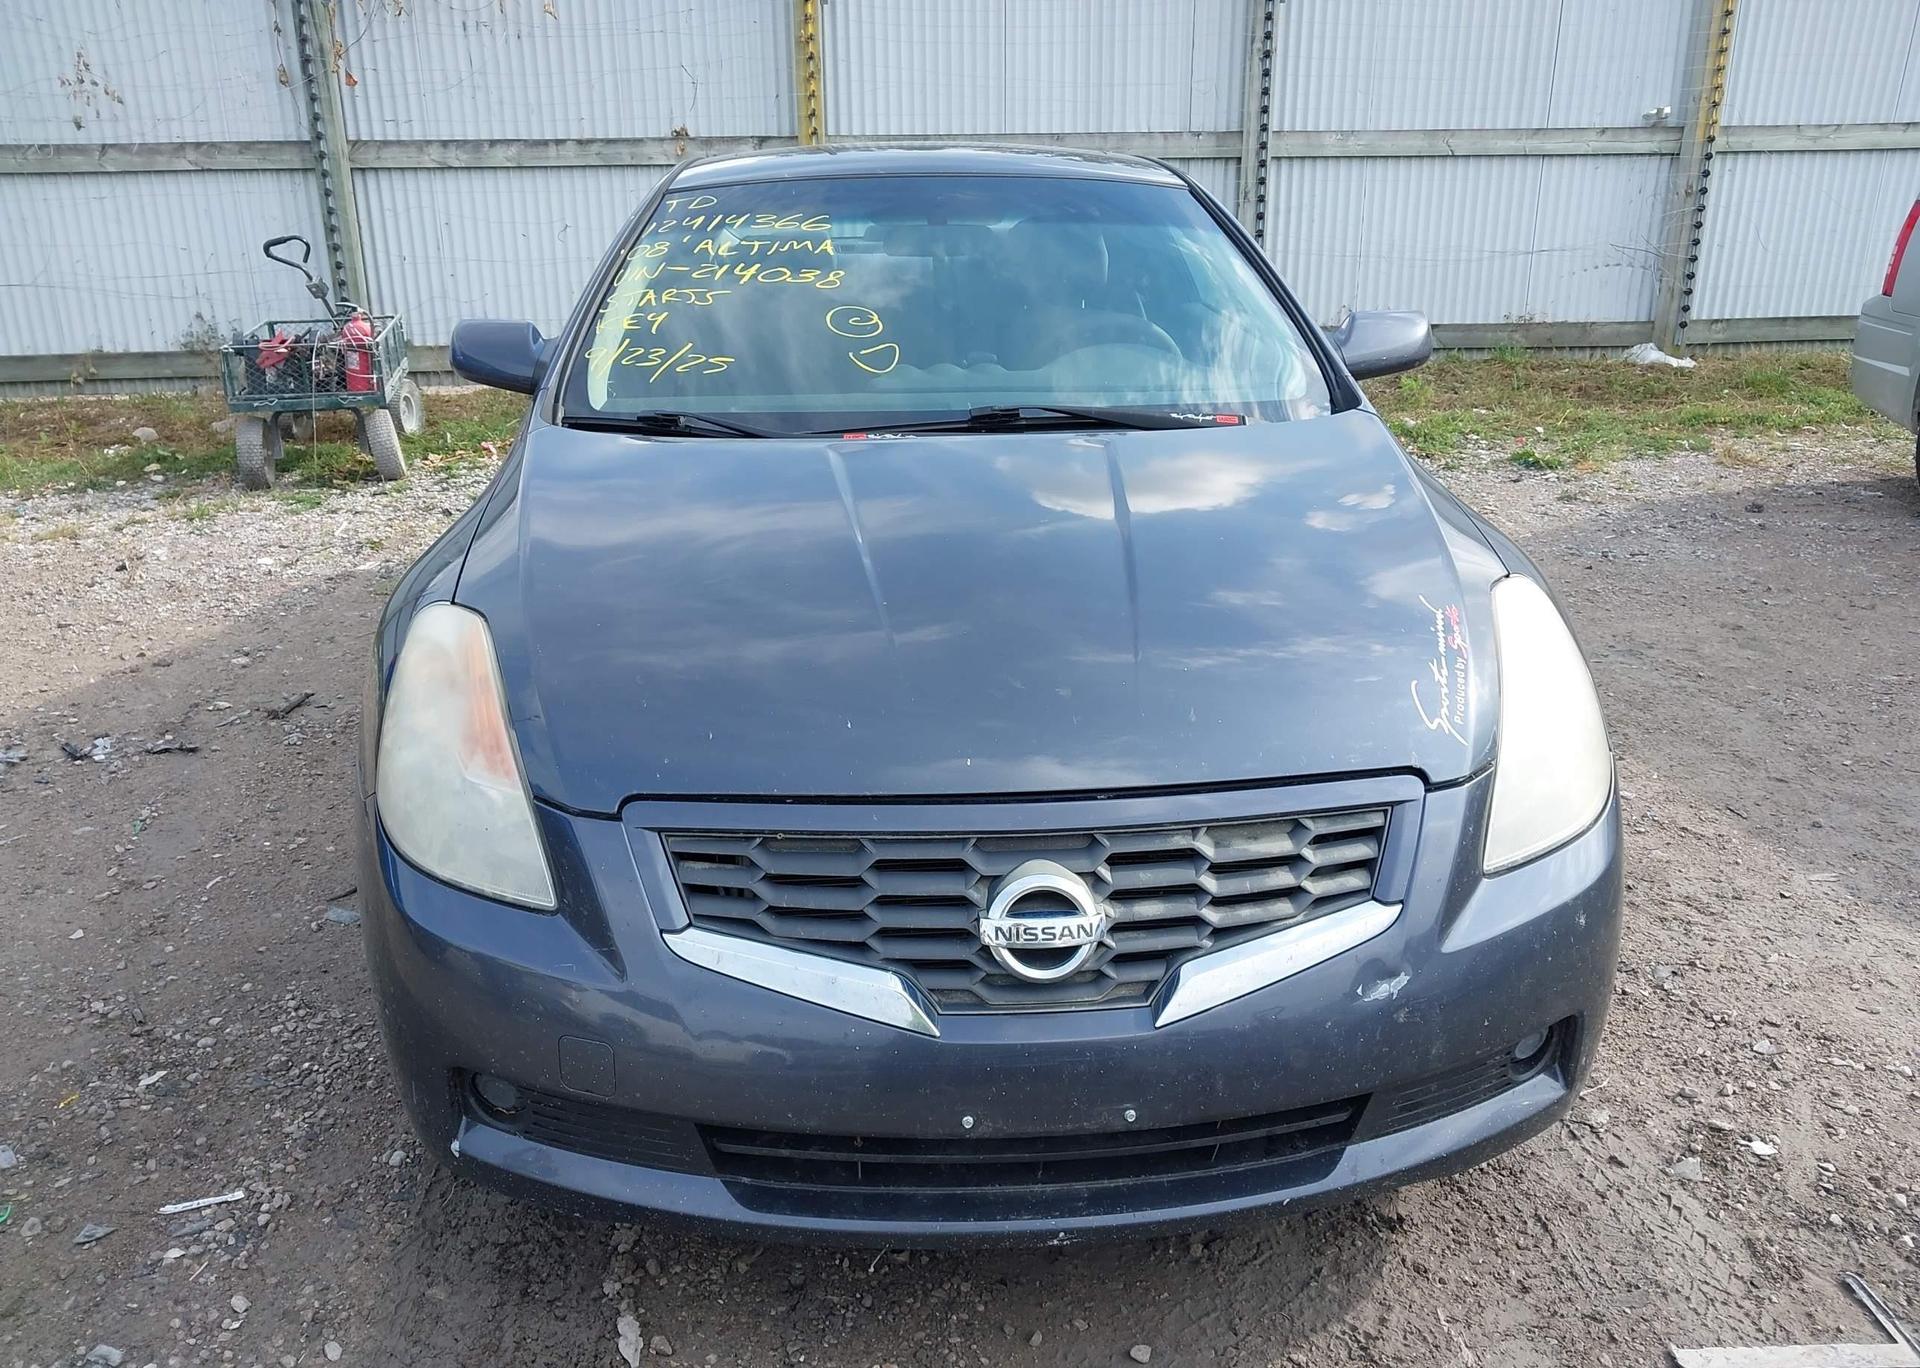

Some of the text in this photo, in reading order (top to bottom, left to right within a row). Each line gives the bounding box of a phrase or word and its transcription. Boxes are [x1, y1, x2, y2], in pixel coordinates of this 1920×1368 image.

[641, 212, 832, 239] 12414366
[585, 338, 735, 383] 9/23/25
[1454, 656, 1467, 668] by
[1453, 668, 1466, 725] Produced
[993, 922, 1094, 942] NISSAN
